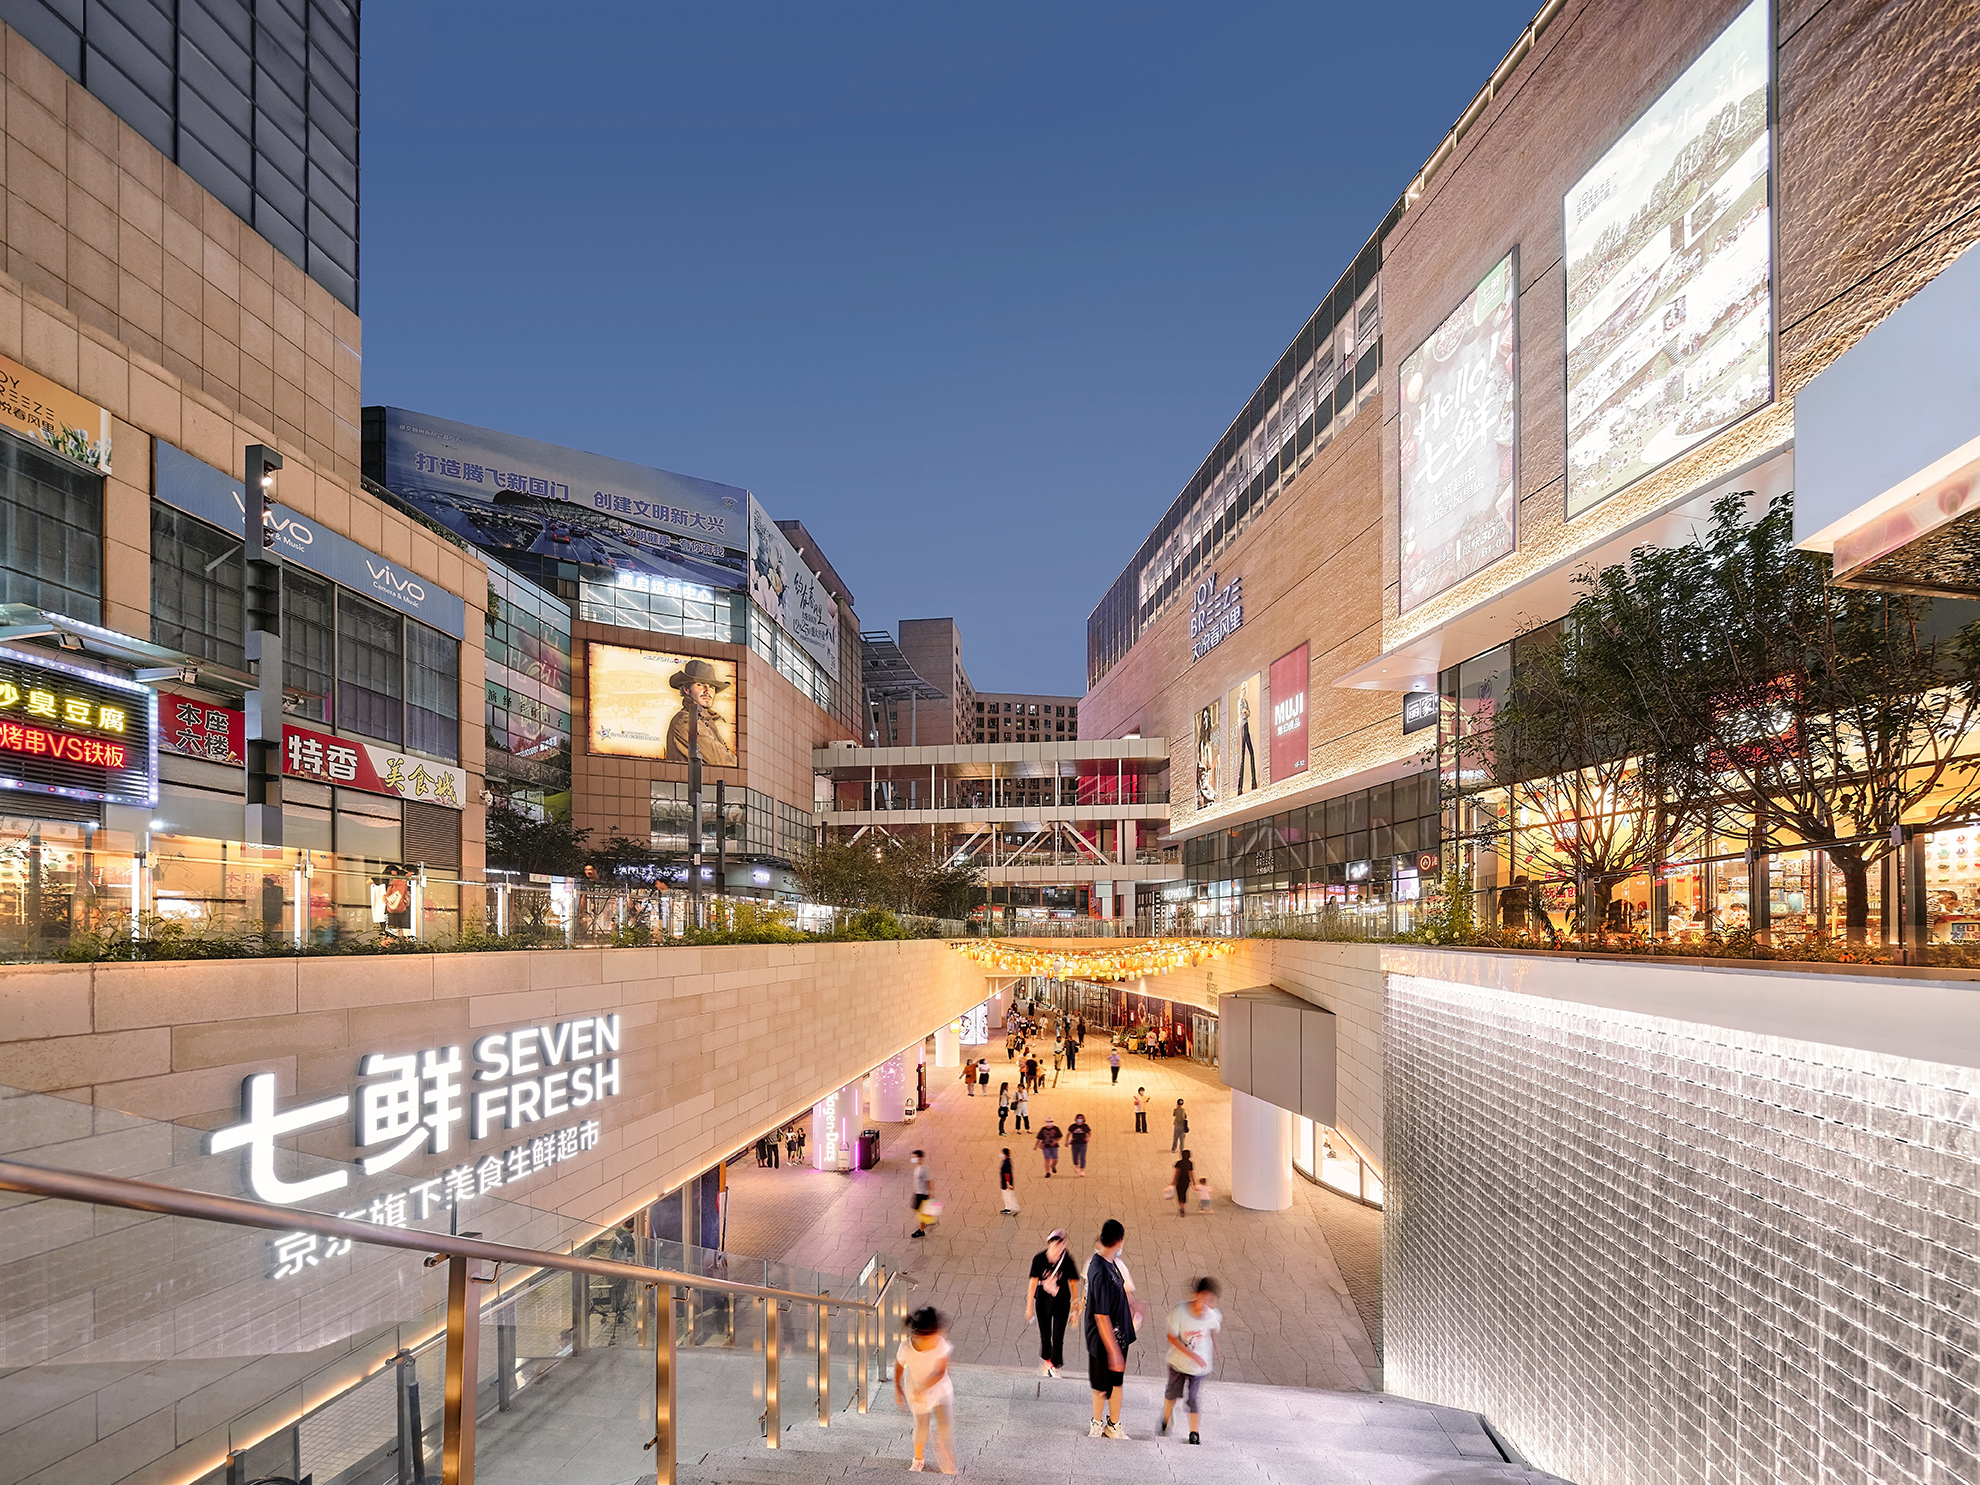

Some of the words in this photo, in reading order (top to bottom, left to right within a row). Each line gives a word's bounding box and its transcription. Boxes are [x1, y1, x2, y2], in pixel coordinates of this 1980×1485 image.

[1577, 185, 1595, 208] JOY
[1413, 331, 1499, 445] Hello!
[1413, 380, 1500, 485] 七鲜
[415, 451, 570, 501] 打造腾飞新国门
[593, 490, 725, 535] 创建文明新大兴
[282, 536, 306, 553] Music
[624, 527, 672, 547] 文明健康
[365, 559, 426, 601] vivo
[372, 581, 397, 598] Camera
[1191, 572, 1217, 613] JOY
[1191, 577, 1242, 639] BREEZE
[1191, 606, 1242, 663] 大悦春风里
[176, 703, 229, 735] 本座
[1275, 692, 1304, 726] MUJI
[176, 728, 229, 758] 六楼
[288, 734, 358, 781] 特香
[384, 758, 458, 803] 美食城
[478, 1013, 620, 1082] SEVEN
[477, 1058, 620, 1138] FRESH
[210, 1044, 462, 1203] 七鲜
